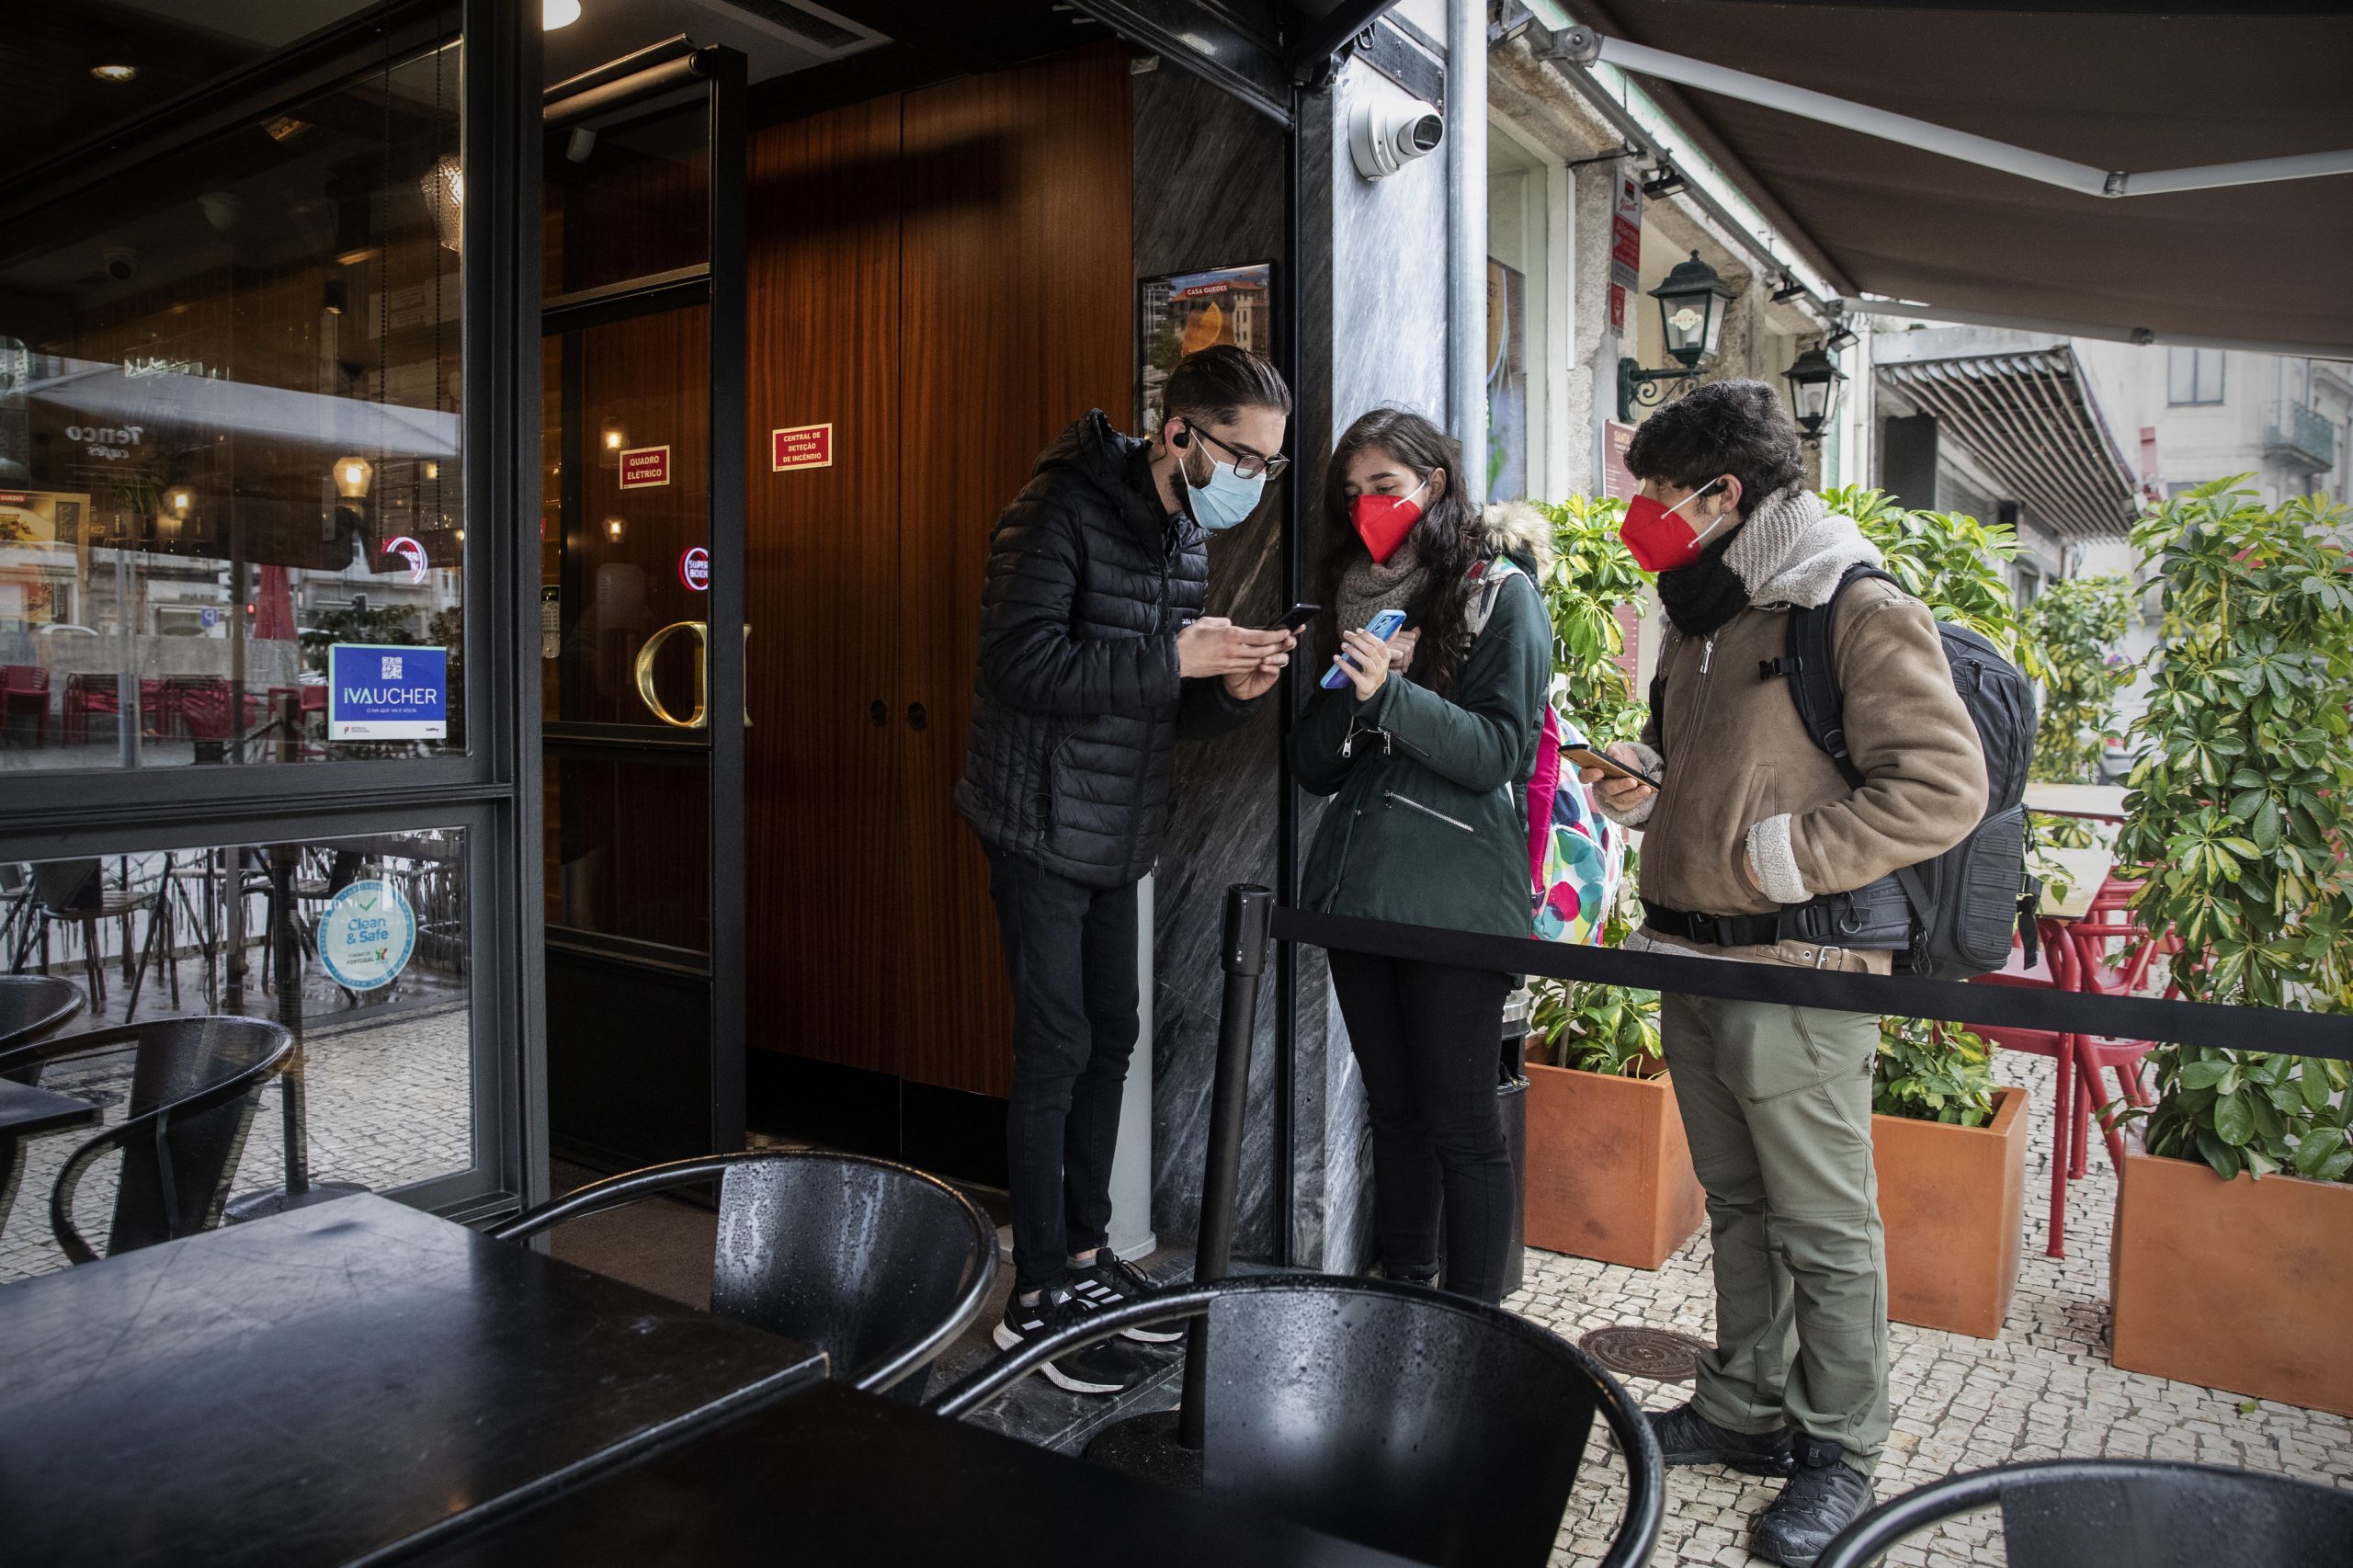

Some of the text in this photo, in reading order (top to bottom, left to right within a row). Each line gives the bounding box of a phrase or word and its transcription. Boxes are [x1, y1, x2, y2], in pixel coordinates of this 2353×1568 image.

[1204, 285, 1228, 293] GUEDES
[783, 431, 821, 442] CENTRAL DE
[788, 442, 816, 452] DETEÇÃO
[630, 455, 660, 467] QUADRO
[792, 452, 822, 462] INCÊNDIO
[627, 469, 663, 481] ELÉTRICO
[347, 917, 386, 931] Clean
[347, 928, 389, 945] & Safe
[347, 957, 374, 965] PORTUGAL
